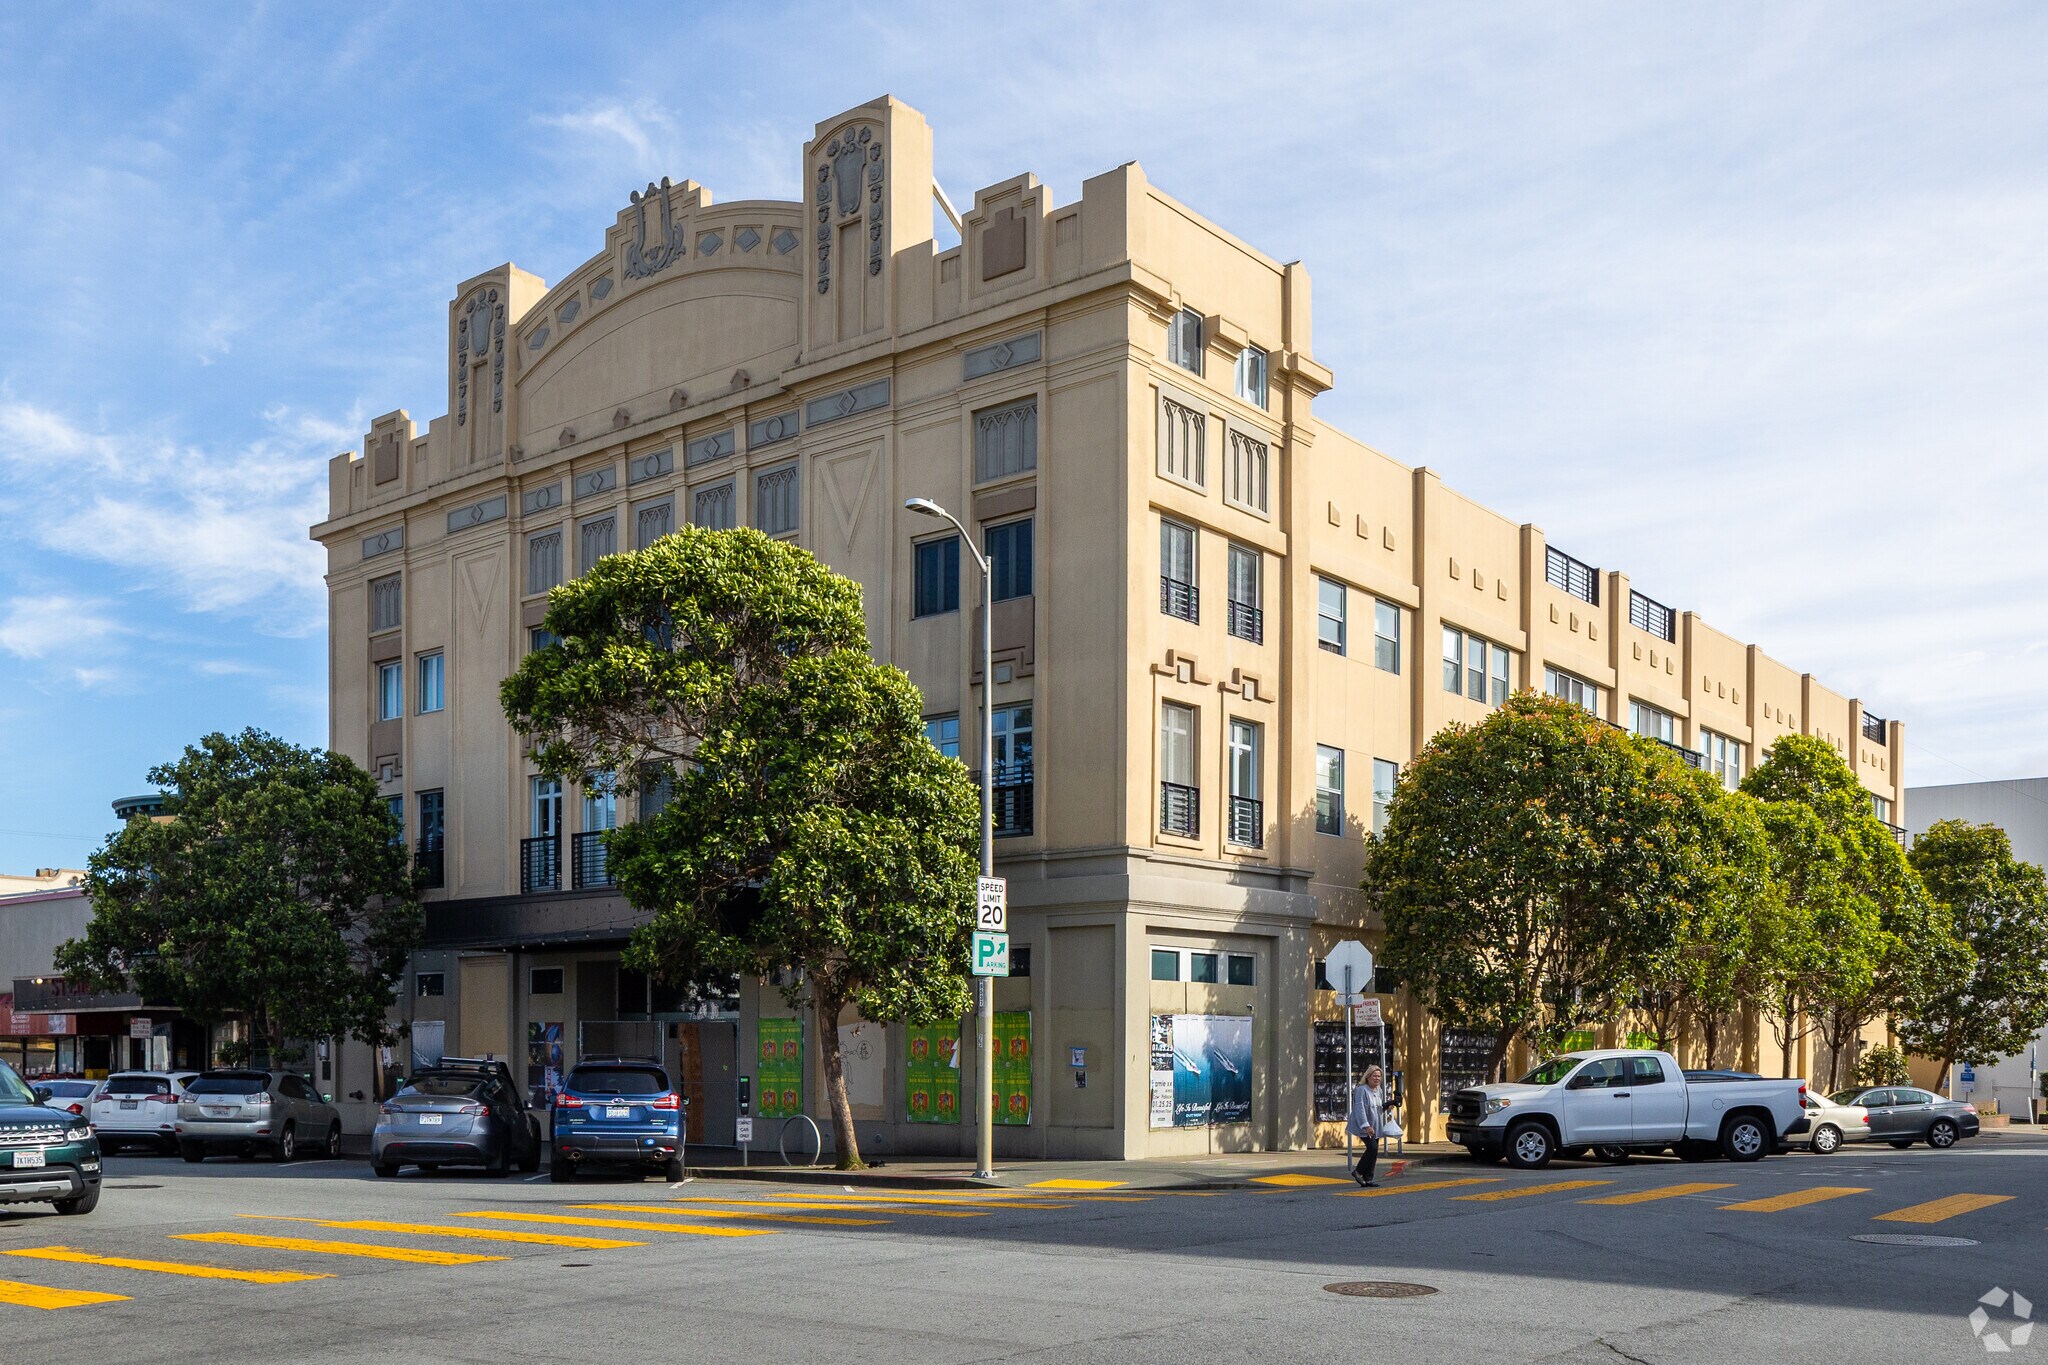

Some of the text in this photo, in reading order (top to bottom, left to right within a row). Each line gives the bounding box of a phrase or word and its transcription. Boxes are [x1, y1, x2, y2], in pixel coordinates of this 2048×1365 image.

[981, 882, 1004, 892] SPEED
[983, 894, 1001, 903] LIMIT
[982, 904, 1003, 925] 20
